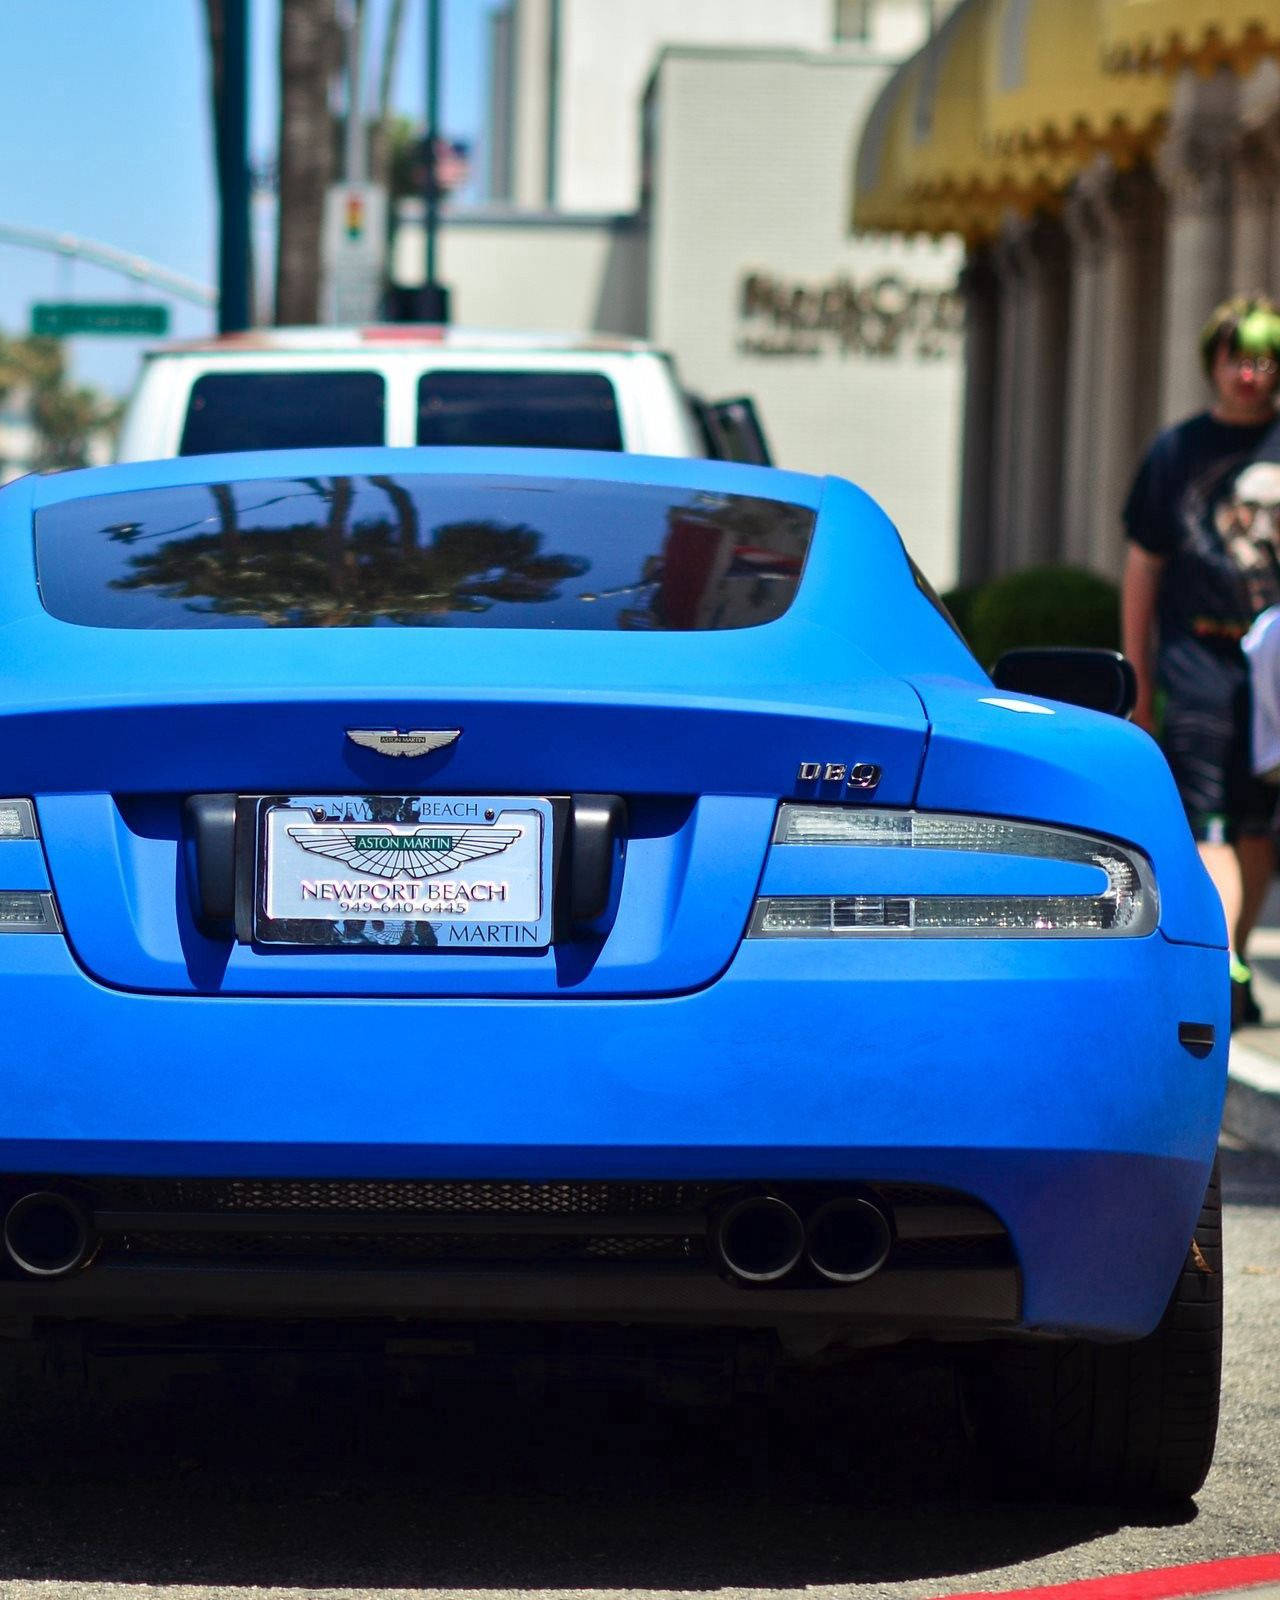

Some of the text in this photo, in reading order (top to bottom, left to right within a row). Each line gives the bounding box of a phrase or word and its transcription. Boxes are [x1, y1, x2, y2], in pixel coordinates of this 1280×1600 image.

[798, 762, 882, 788] DB9
[422, 802, 478, 817] BEACH
[357, 837, 450, 849] ASTON MARTIN
[301, 883, 506, 901] NEWPORT BEACH
[339, 901, 467, 914] 949-640-6445
[448, 924, 538, 943] MARTIN
